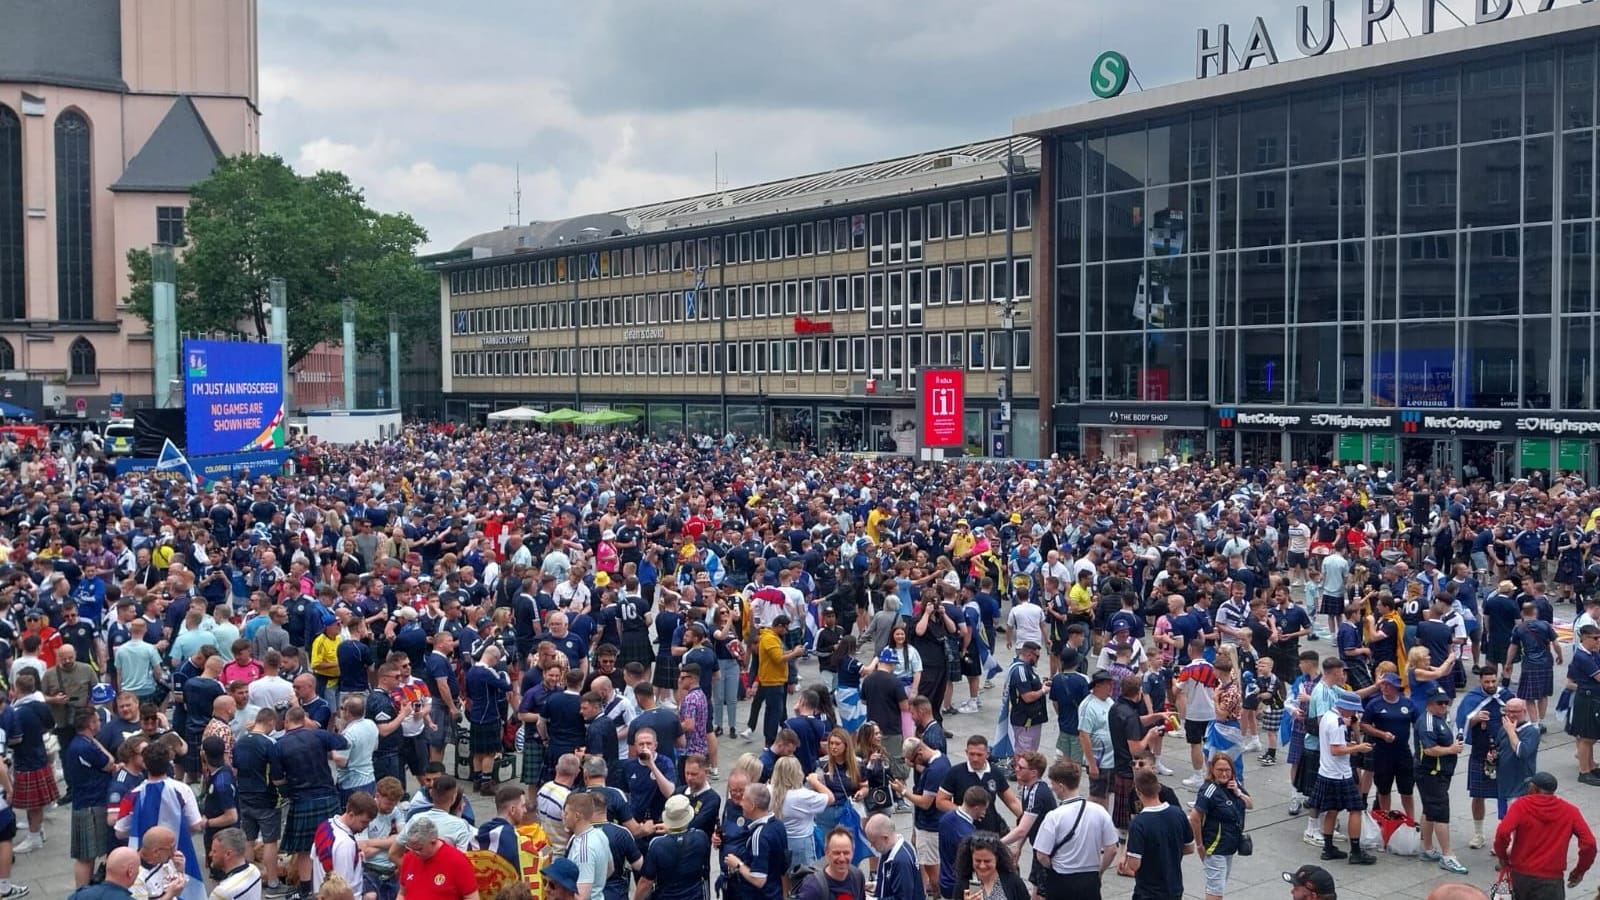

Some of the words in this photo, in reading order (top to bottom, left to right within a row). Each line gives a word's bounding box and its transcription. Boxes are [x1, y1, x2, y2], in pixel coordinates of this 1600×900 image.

[1096, 57, 1119, 92] S
[509, 334, 528, 344] COFFEE
[192, 383, 204, 395] I'M
[205, 383, 223, 394] JUST
[224, 383, 235, 394] AN
[236, 383, 278, 394] INFOSCREEN
[211, 404, 222, 416] NO
[223, 403, 249, 415] GAMES
[249, 402, 263, 414] ARE
[214, 419, 243, 432] SHOWN
[243, 418, 262, 429] HERE
[1151, 414, 1168, 422] SHOP
[1237, 413, 1300, 426] NetCologne
[1329, 414, 1392, 429] Highspeed
[1424, 416, 1502, 432] NetCologne
[621, 603, 637, 620] 10
[1403, 601, 1419, 614] 10
